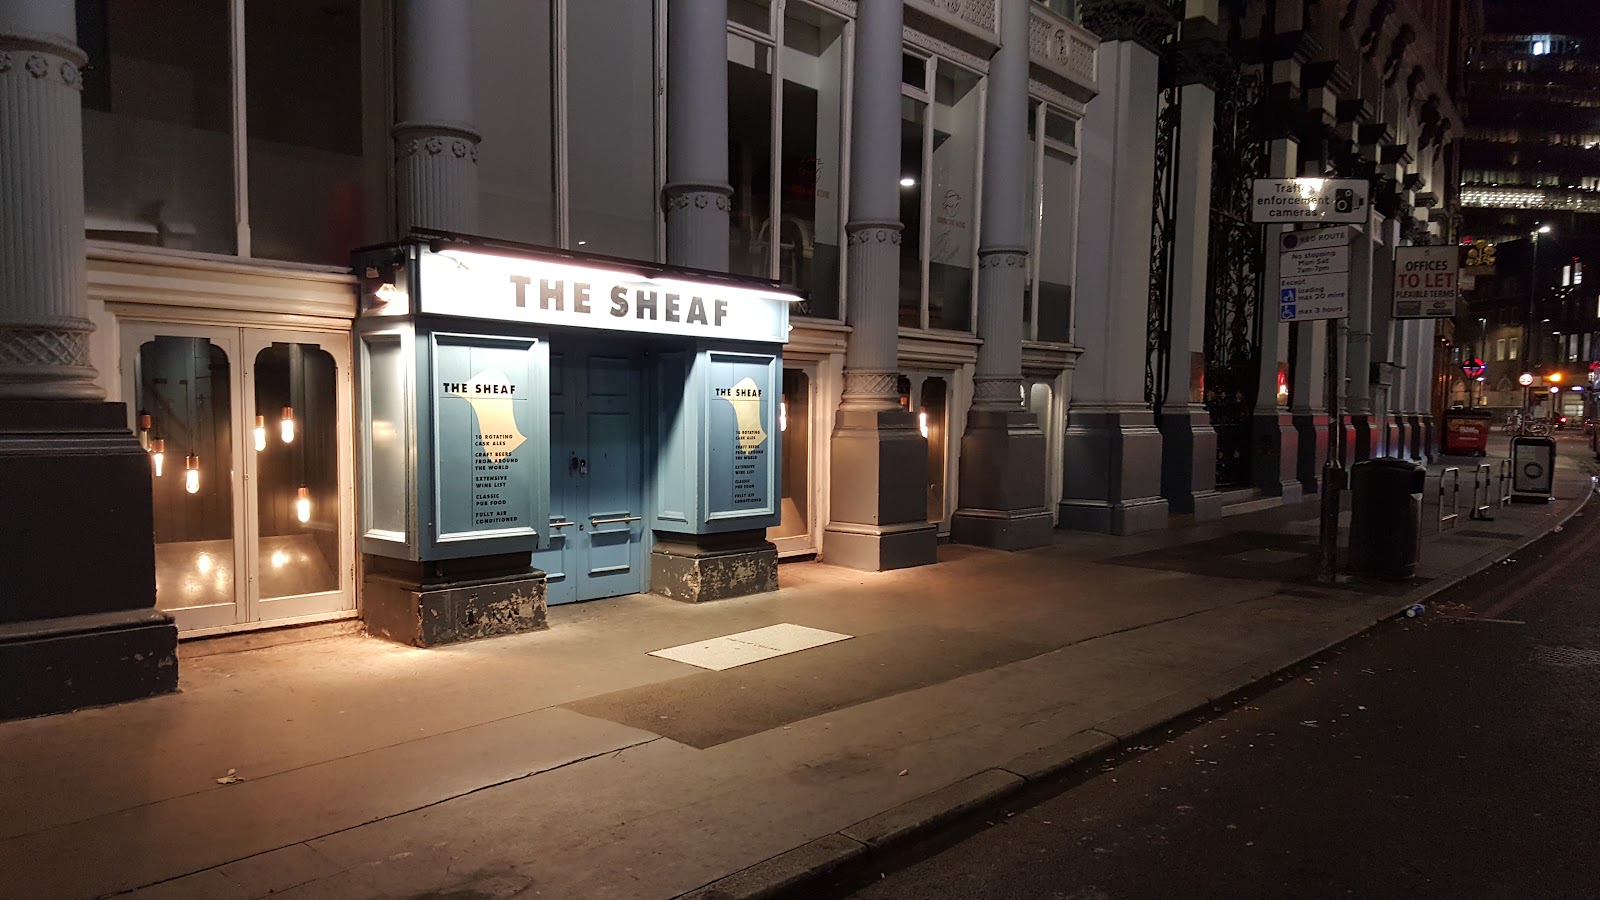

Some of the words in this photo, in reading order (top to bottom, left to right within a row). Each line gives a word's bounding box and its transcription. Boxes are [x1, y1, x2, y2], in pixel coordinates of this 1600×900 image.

[1275, 184, 1312, 192] Traff
[1257, 196, 1330, 205] enforcement
[1269, 209, 1318, 217] cameras
[1319, 233, 1345, 241] ROUTE
[1305, 251, 1336, 259] stopping
[1406, 261, 1448, 271] OFFICES
[1398, 274, 1420, 288] TO
[1425, 273, 1454, 288] LET
[1396, 290, 1428, 298] FLEXIBLE
[1430, 290, 1454, 298] TERMS
[510, 275, 591, 314] THE
[609, 285, 728, 327] SHEAF
[443, 383, 467, 393] THE
[476, 384, 515, 394] SHEAF
[716, 388, 731, 396] THE
[736, 389, 762, 397] SHEAF
